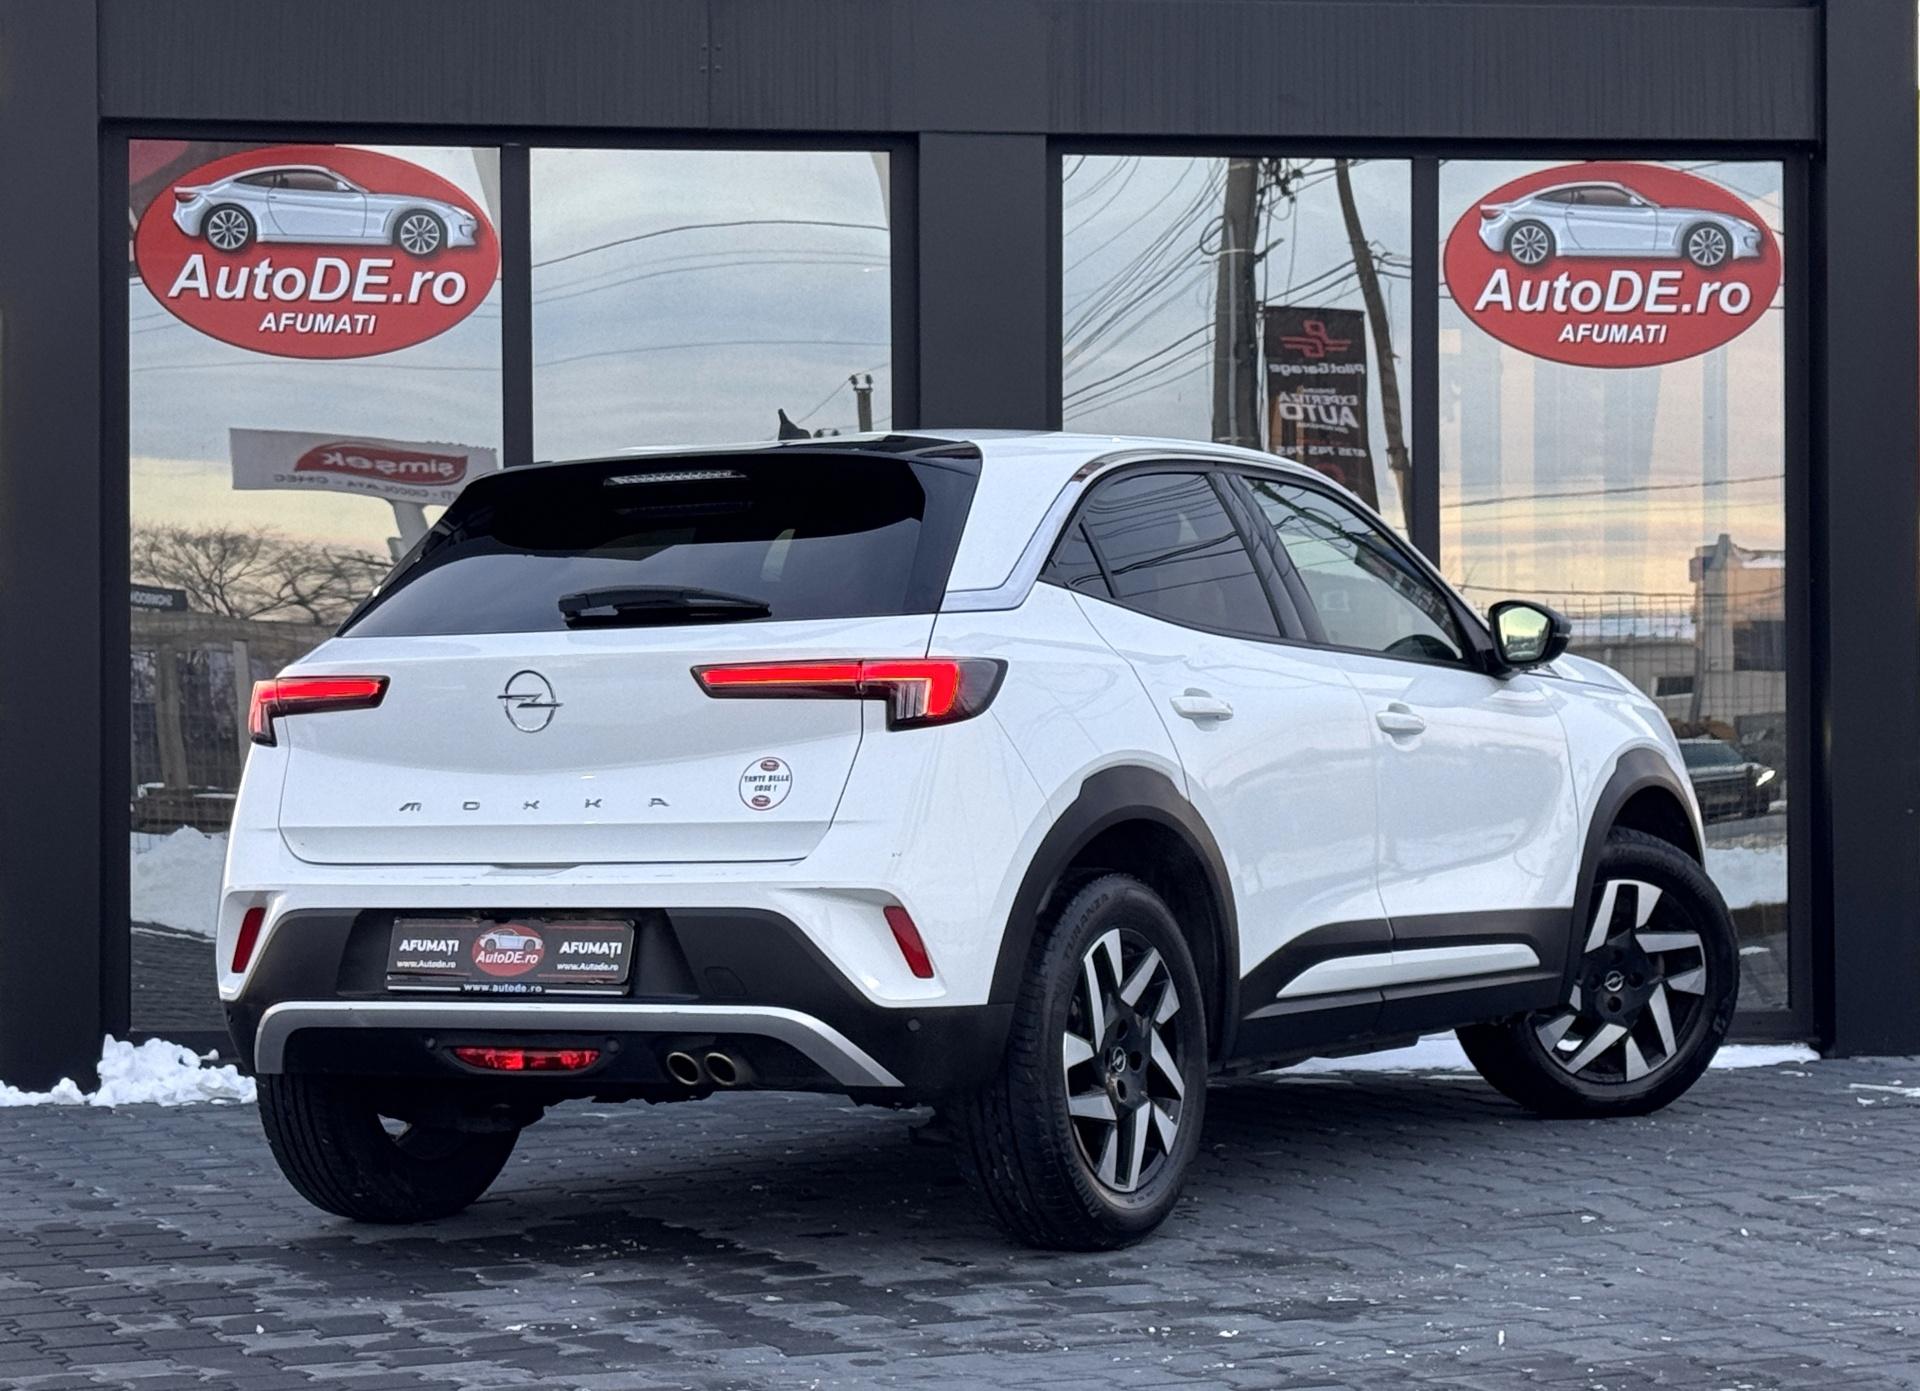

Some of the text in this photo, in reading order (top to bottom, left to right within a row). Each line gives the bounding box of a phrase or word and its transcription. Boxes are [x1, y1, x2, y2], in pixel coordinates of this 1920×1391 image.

[168, 253, 467, 306] AutoDE.ro
[1474, 268, 1751, 315] AutoDE.ro
[259, 313, 377, 335] AFUMATI
[1558, 324, 1668, 344] AFUMATI
[768, 774, 790, 782] BELLE
[398, 797, 670, 812] MOKKA
[397, 960, 456, 968] www.Autode.ro
[476, 951, 539, 965] AutoDE.ro
[557, 963, 619, 971] www.Autode.ro
[463, 983, 543, 994] www.autode.ro
